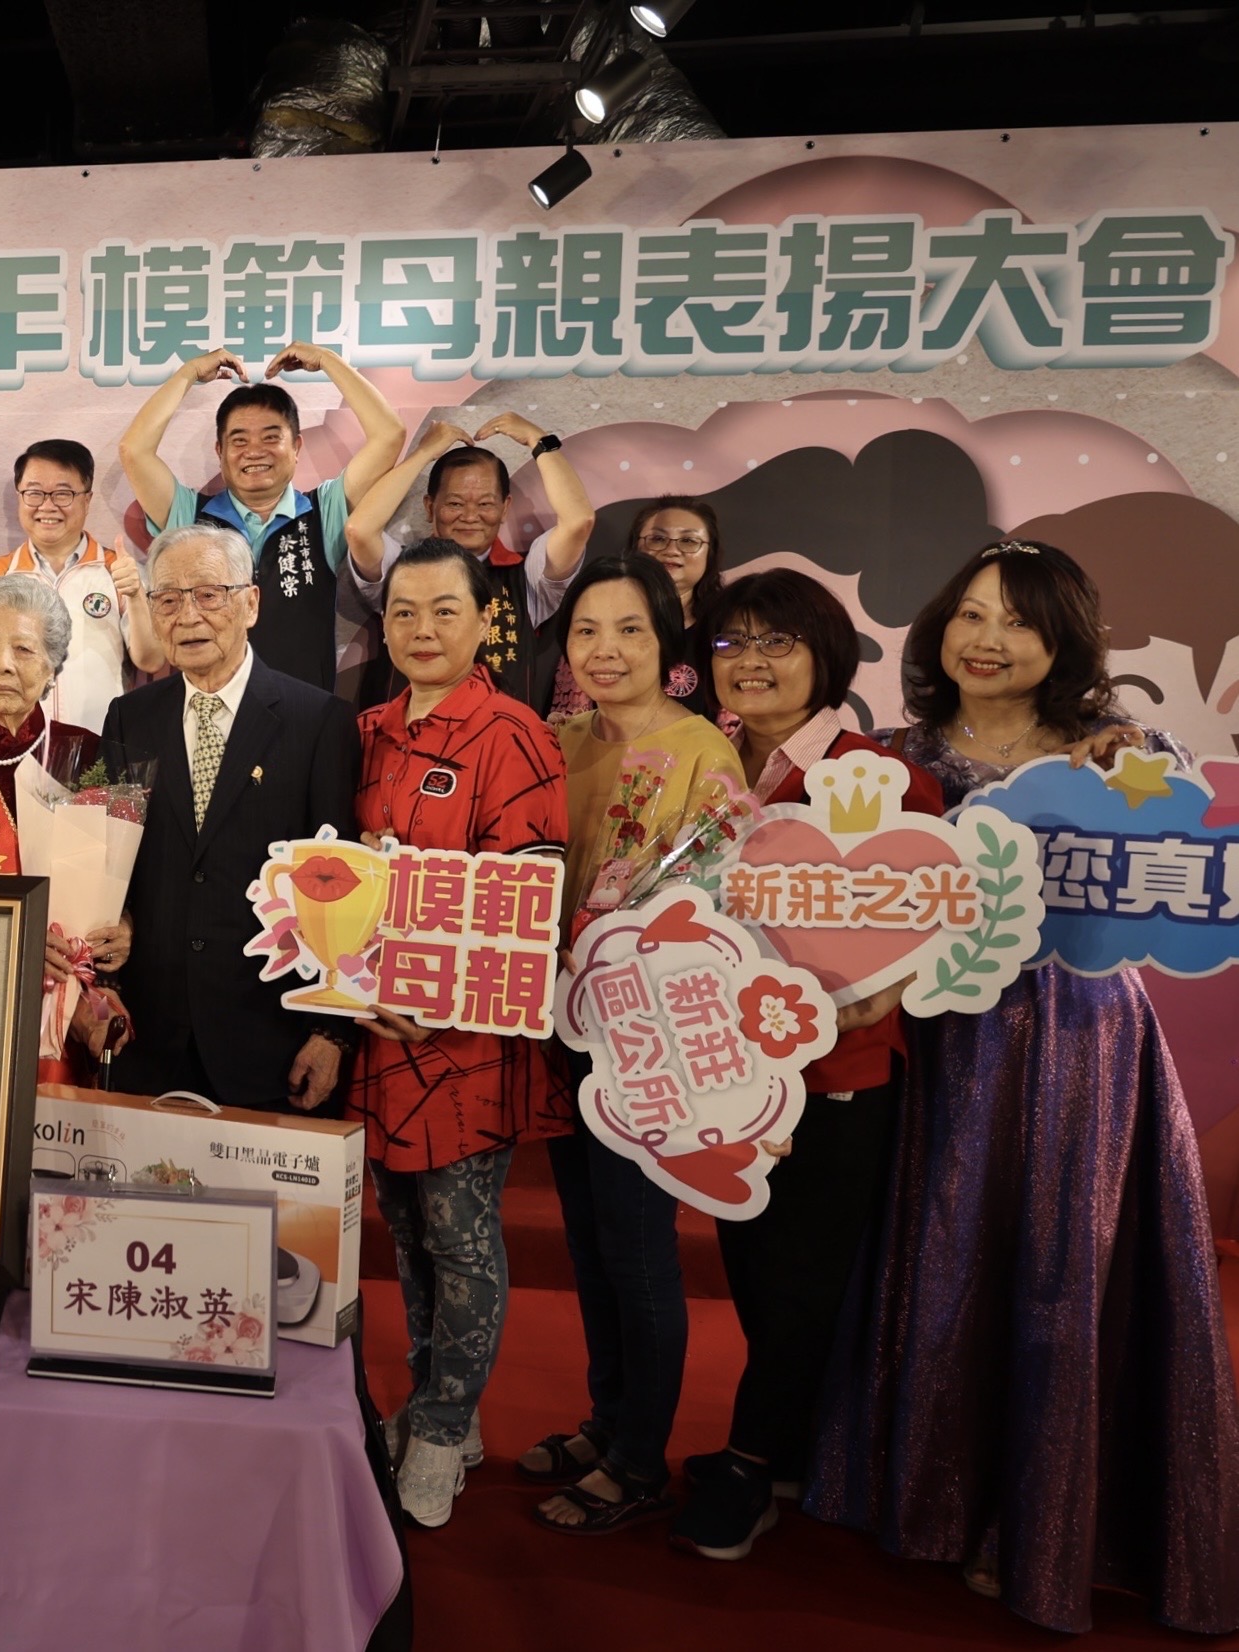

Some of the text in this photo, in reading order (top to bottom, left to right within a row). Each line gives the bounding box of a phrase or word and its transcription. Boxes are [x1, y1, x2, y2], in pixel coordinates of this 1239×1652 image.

[278, 534, 299, 598] 蔡健棠
[298, 521, 315, 585] 新北市議員
[427, 774, 449, 788] 52
[384, 853, 556, 941] 模範
[726, 868, 977, 925] 新莊之光
[1036, 832, 1239, 920] 您真
[378, 940, 548, 1031] 母親
[590, 961, 687, 1127] 區公所
[665, 972, 746, 1088] 新莊
[126, 1240, 177, 1275] 04
[64, 1278, 235, 1328] 宋陳淑英
